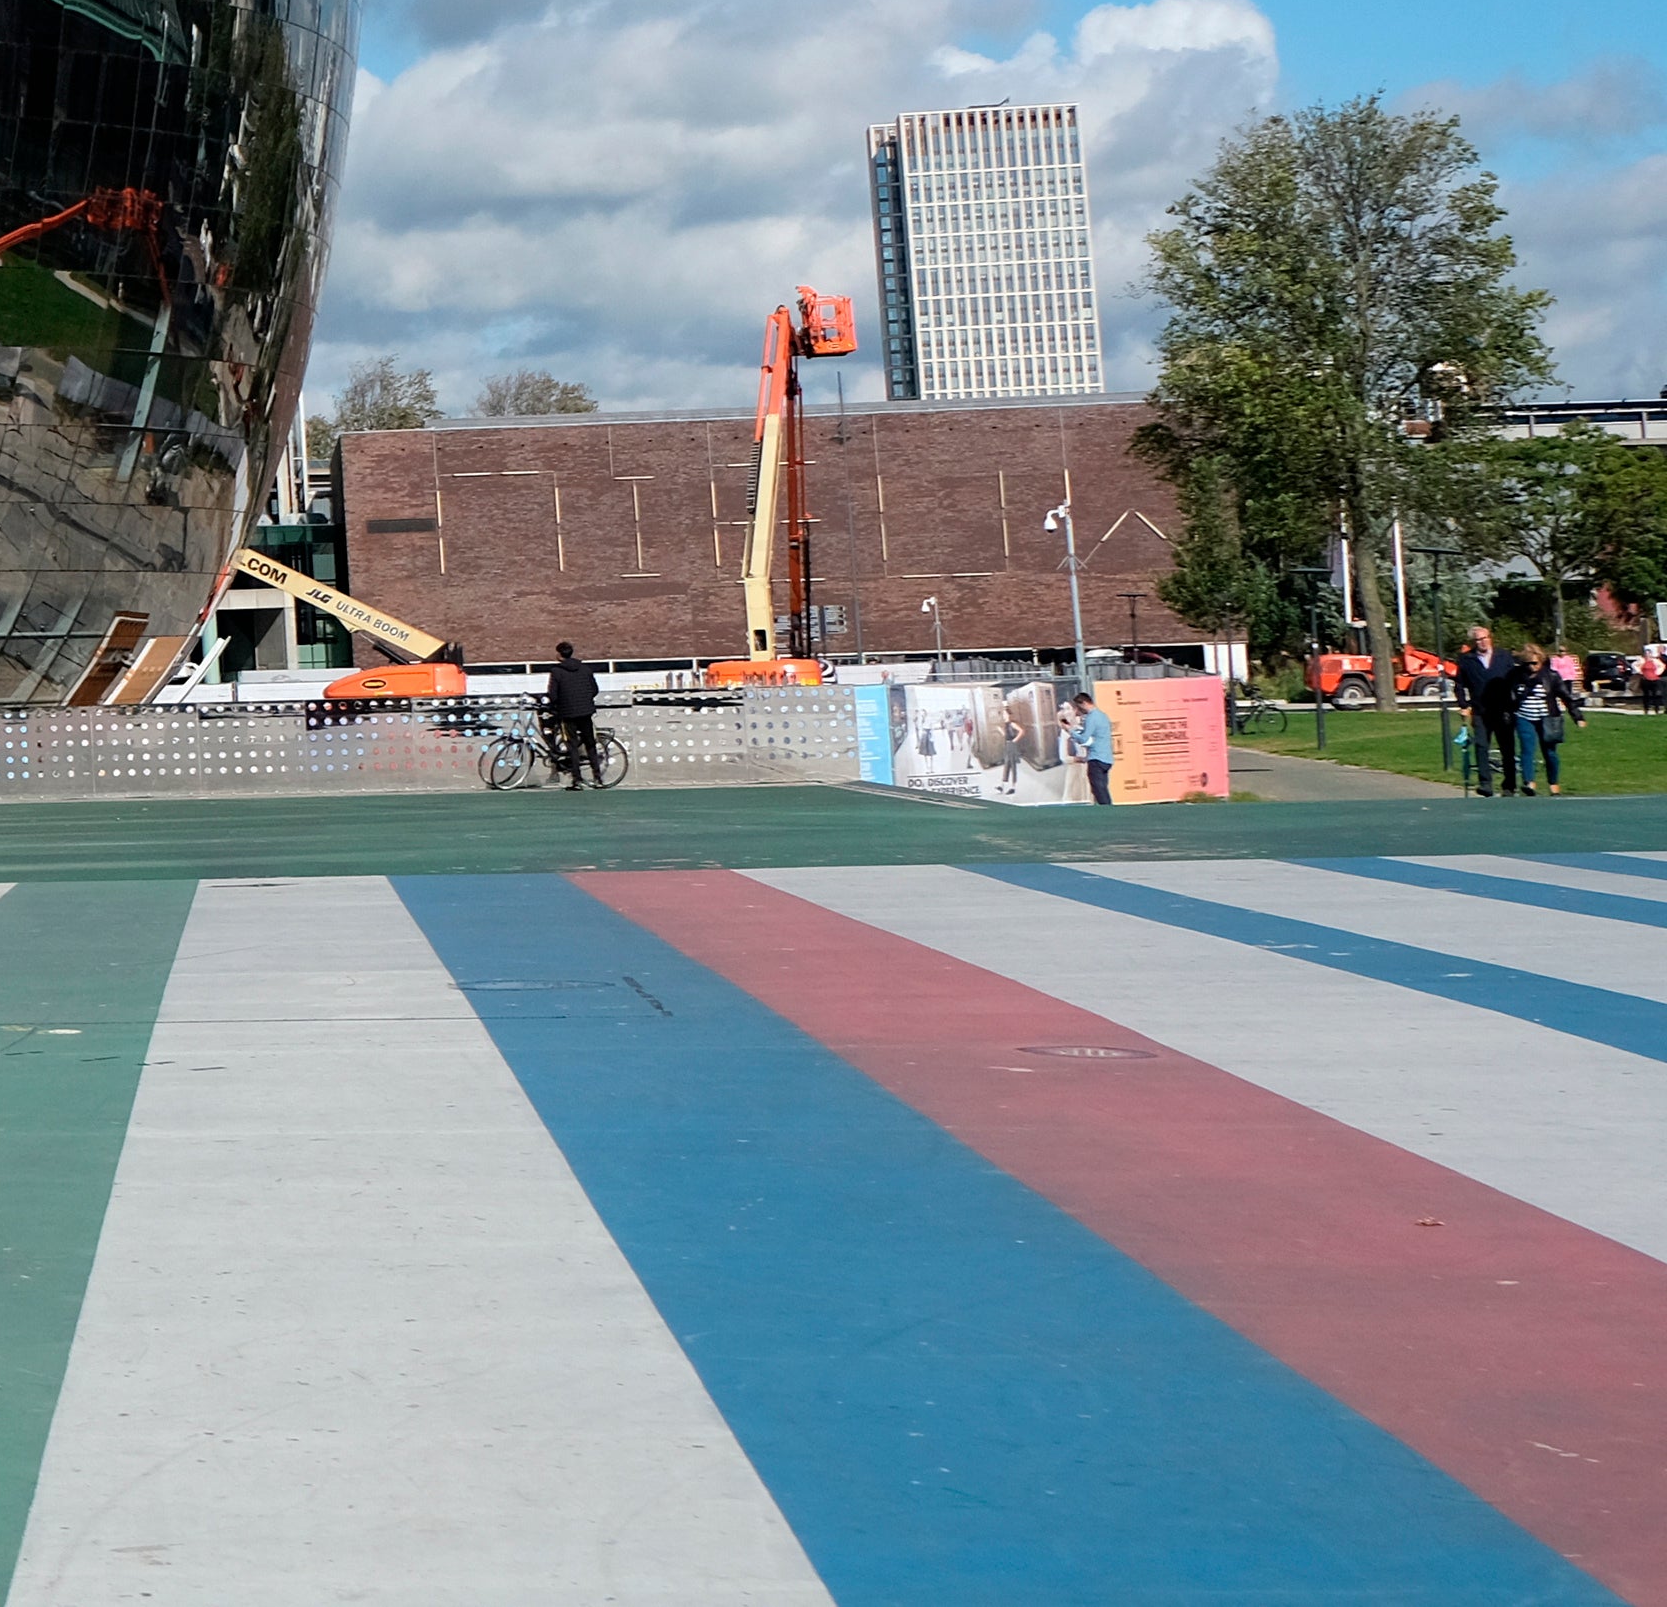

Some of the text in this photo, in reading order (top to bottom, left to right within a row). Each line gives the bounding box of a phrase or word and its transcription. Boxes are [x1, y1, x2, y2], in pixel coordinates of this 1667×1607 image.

[305, 587, 411, 642] JLG ULTRA BOOM
[928, 776, 969, 787] DISCOVER
